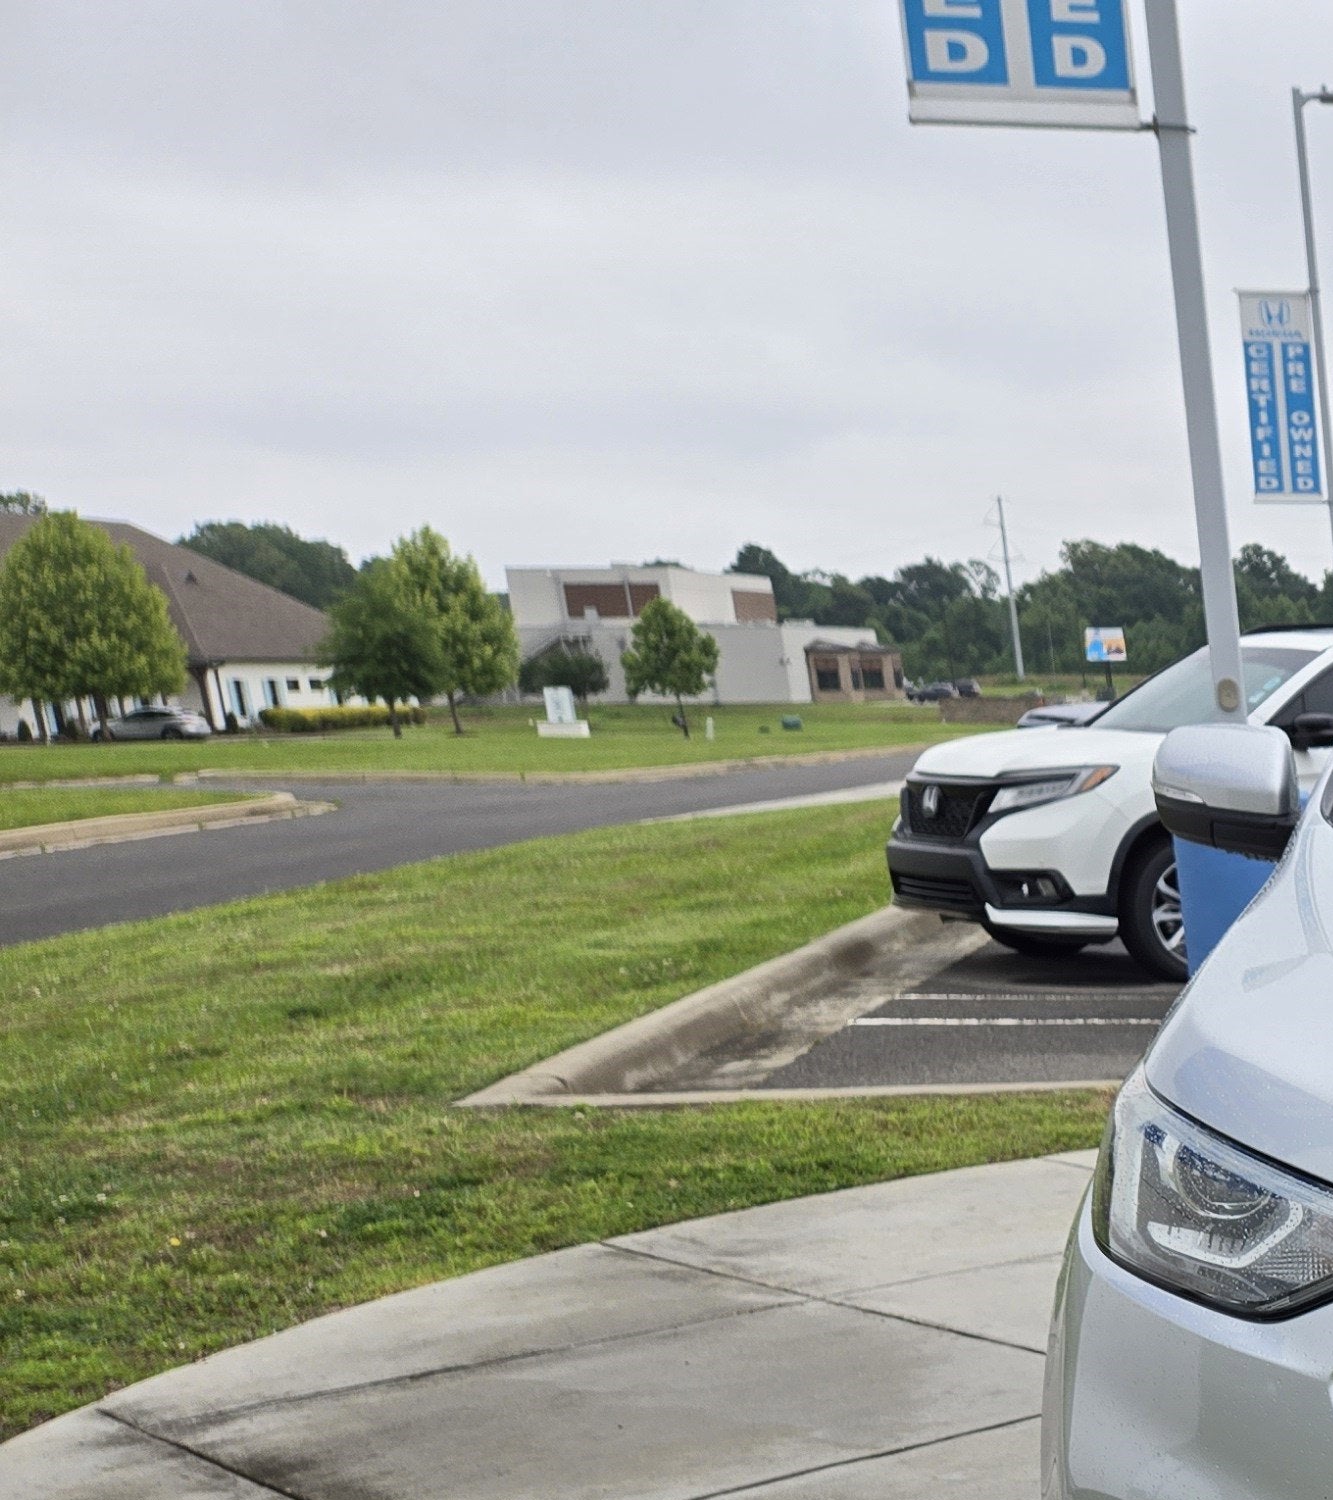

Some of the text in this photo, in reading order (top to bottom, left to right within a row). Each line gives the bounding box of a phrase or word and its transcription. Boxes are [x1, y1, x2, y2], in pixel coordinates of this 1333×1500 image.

[1247, 342, 1280, 490] CERTIFIED
[1287, 344, 1315, 490] PRE OWNED
